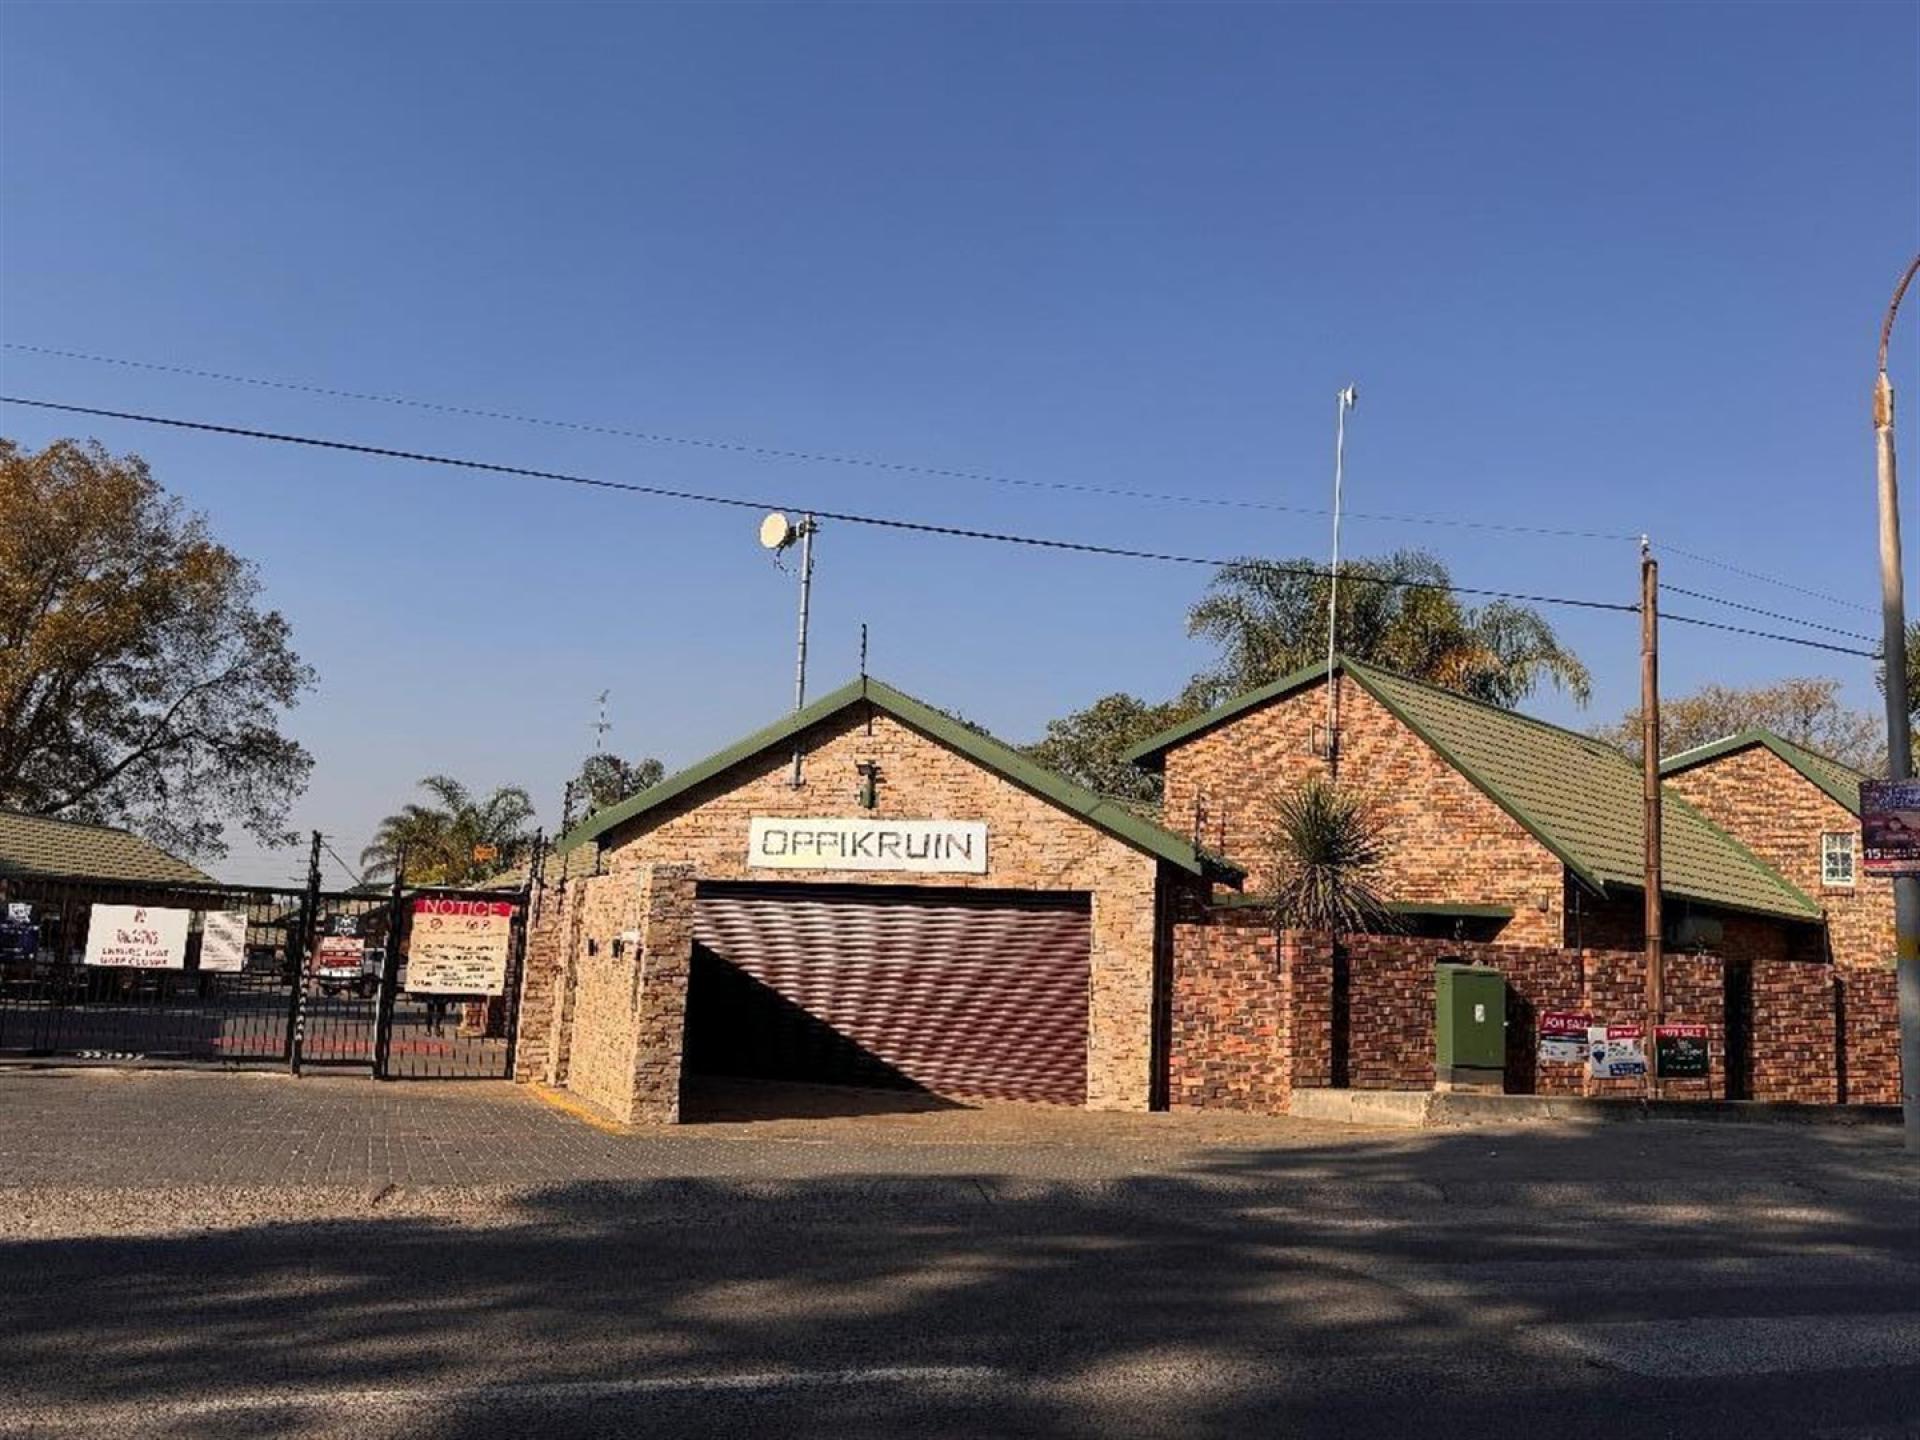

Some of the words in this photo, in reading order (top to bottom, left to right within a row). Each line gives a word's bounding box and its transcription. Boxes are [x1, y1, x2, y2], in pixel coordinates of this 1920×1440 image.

[761, 829, 972, 861] OPPIKRUIN
[424, 900, 499, 917] NOTICE
[1544, 1017, 1564, 1028] FOR
[1566, 1018, 1589, 1030] SALE
